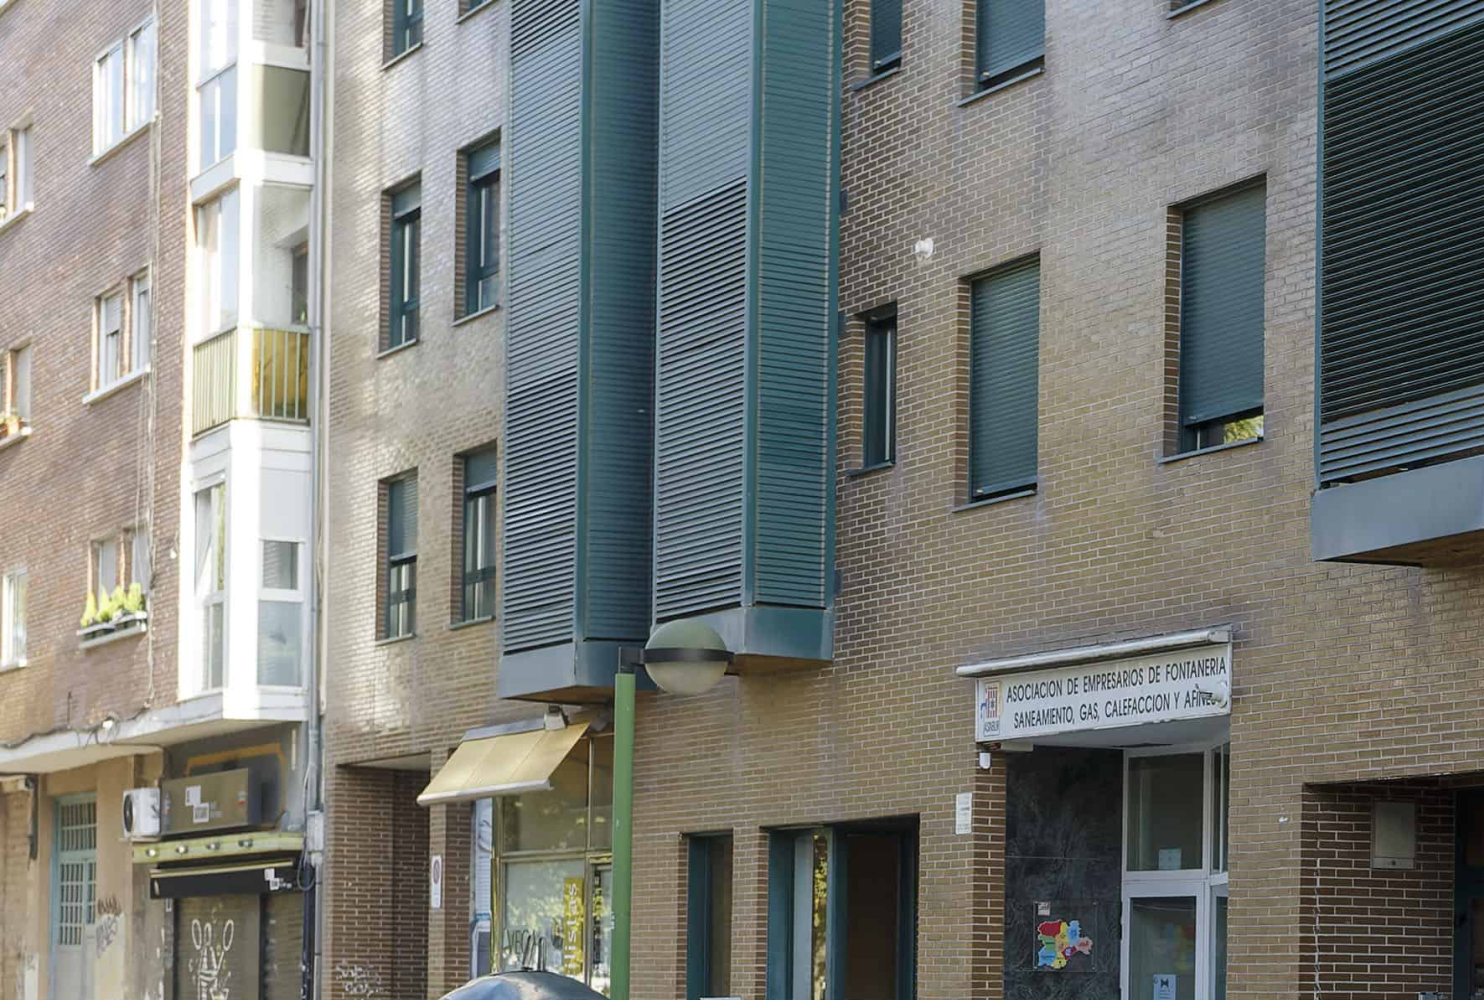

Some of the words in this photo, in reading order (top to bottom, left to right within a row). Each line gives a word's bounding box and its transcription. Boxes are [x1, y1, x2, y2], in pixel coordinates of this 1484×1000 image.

[1006, 680, 1062, 703] ASOCIACION
[1067, 677, 1079, 695] DE
[1083, 668, 1144, 693] EMPRESARIOS
[1148, 665, 1161, 684] DE
[1166, 657, 1226, 682] FONTANERIA
[1013, 706, 1075, 729] SANEAMIENTO,
[1080, 702, 1100, 722] GAS,
[1104, 693, 1170, 718] CALEFACCION
[1173, 691, 1181, 710] Y
